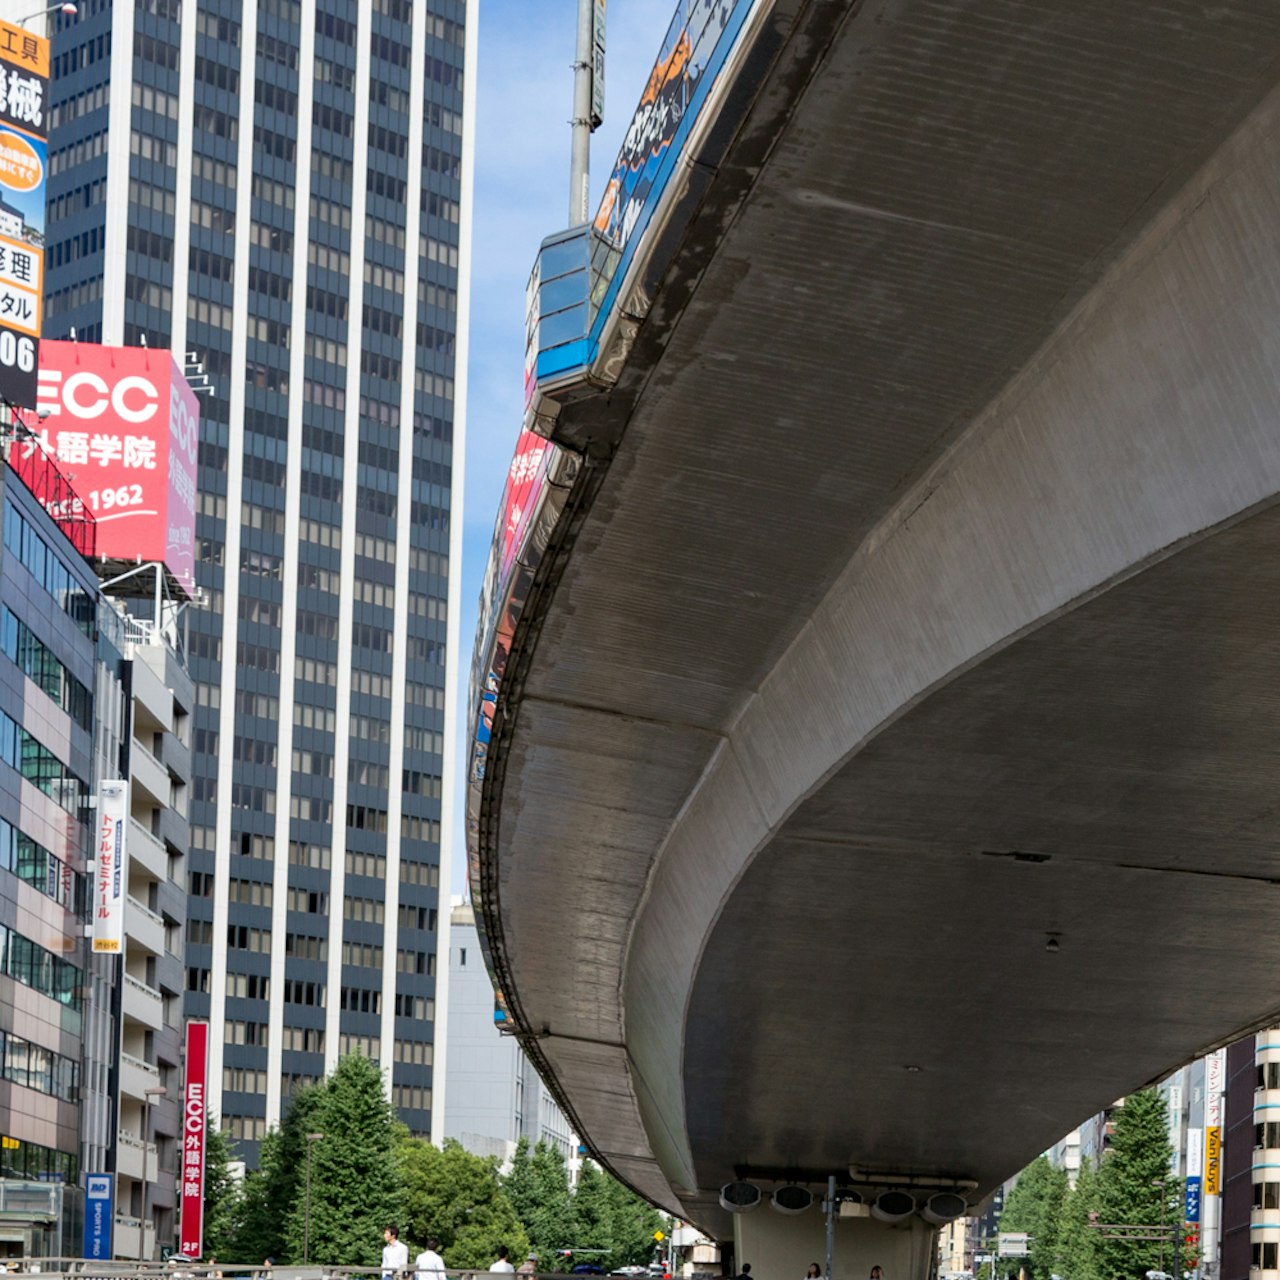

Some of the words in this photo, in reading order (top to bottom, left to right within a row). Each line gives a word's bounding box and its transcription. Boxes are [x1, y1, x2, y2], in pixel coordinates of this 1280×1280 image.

[37, 369, 159, 423] ECC
[21, 428, 157, 469] 外語学院
[88, 484, 144, 510] 1962
[97, 813, 113, 920] トフルゼミナール
[1209, 1058, 1220, 1126] ミシンシティ
[1208, 1128, 1220, 1193] VanNuys
[182, 1242, 198, 1252] 2F
